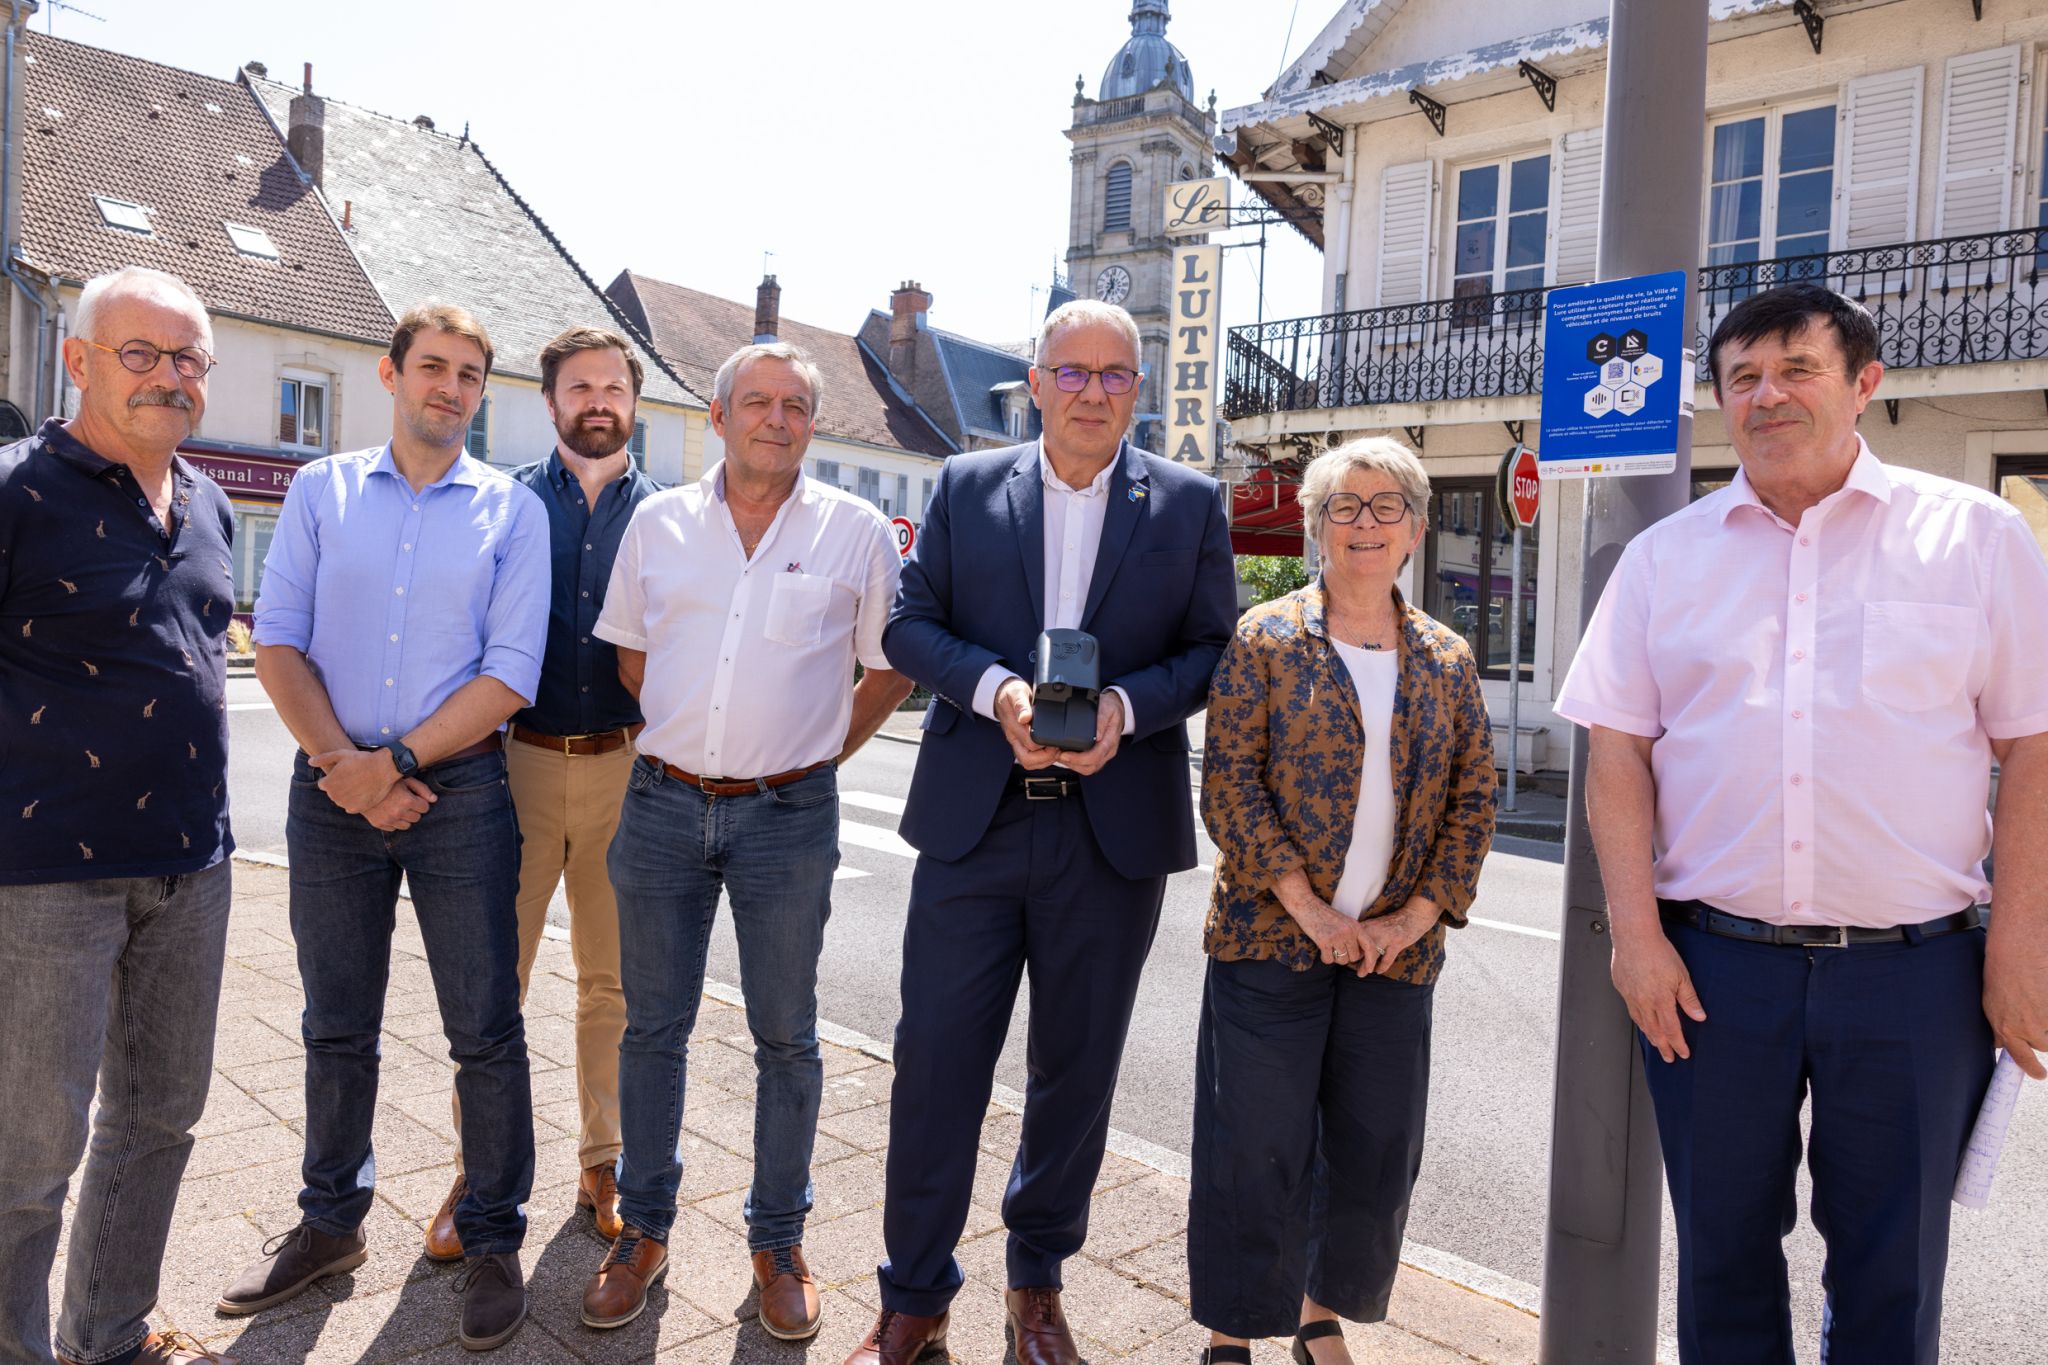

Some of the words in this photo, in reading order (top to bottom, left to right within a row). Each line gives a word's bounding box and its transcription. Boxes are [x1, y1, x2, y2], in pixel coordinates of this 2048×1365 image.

[1169, 184, 1221, 228] Le
[1568, 299, 1595, 307] améliorer
[1603, 294, 1625, 303] qualité
[1565, 320, 1592, 328] véhicules
[1610, 315, 1633, 323] niveaux
[1593, 309, 1623, 318] anonymes
[1172, 254, 1210, 462] LUTHRA
[197, 463, 252, 483] isanal
[272, 471, 293, 486] Pâ
[1515, 476, 1538, 500] STOP
[896, 528, 908, 546] 0
